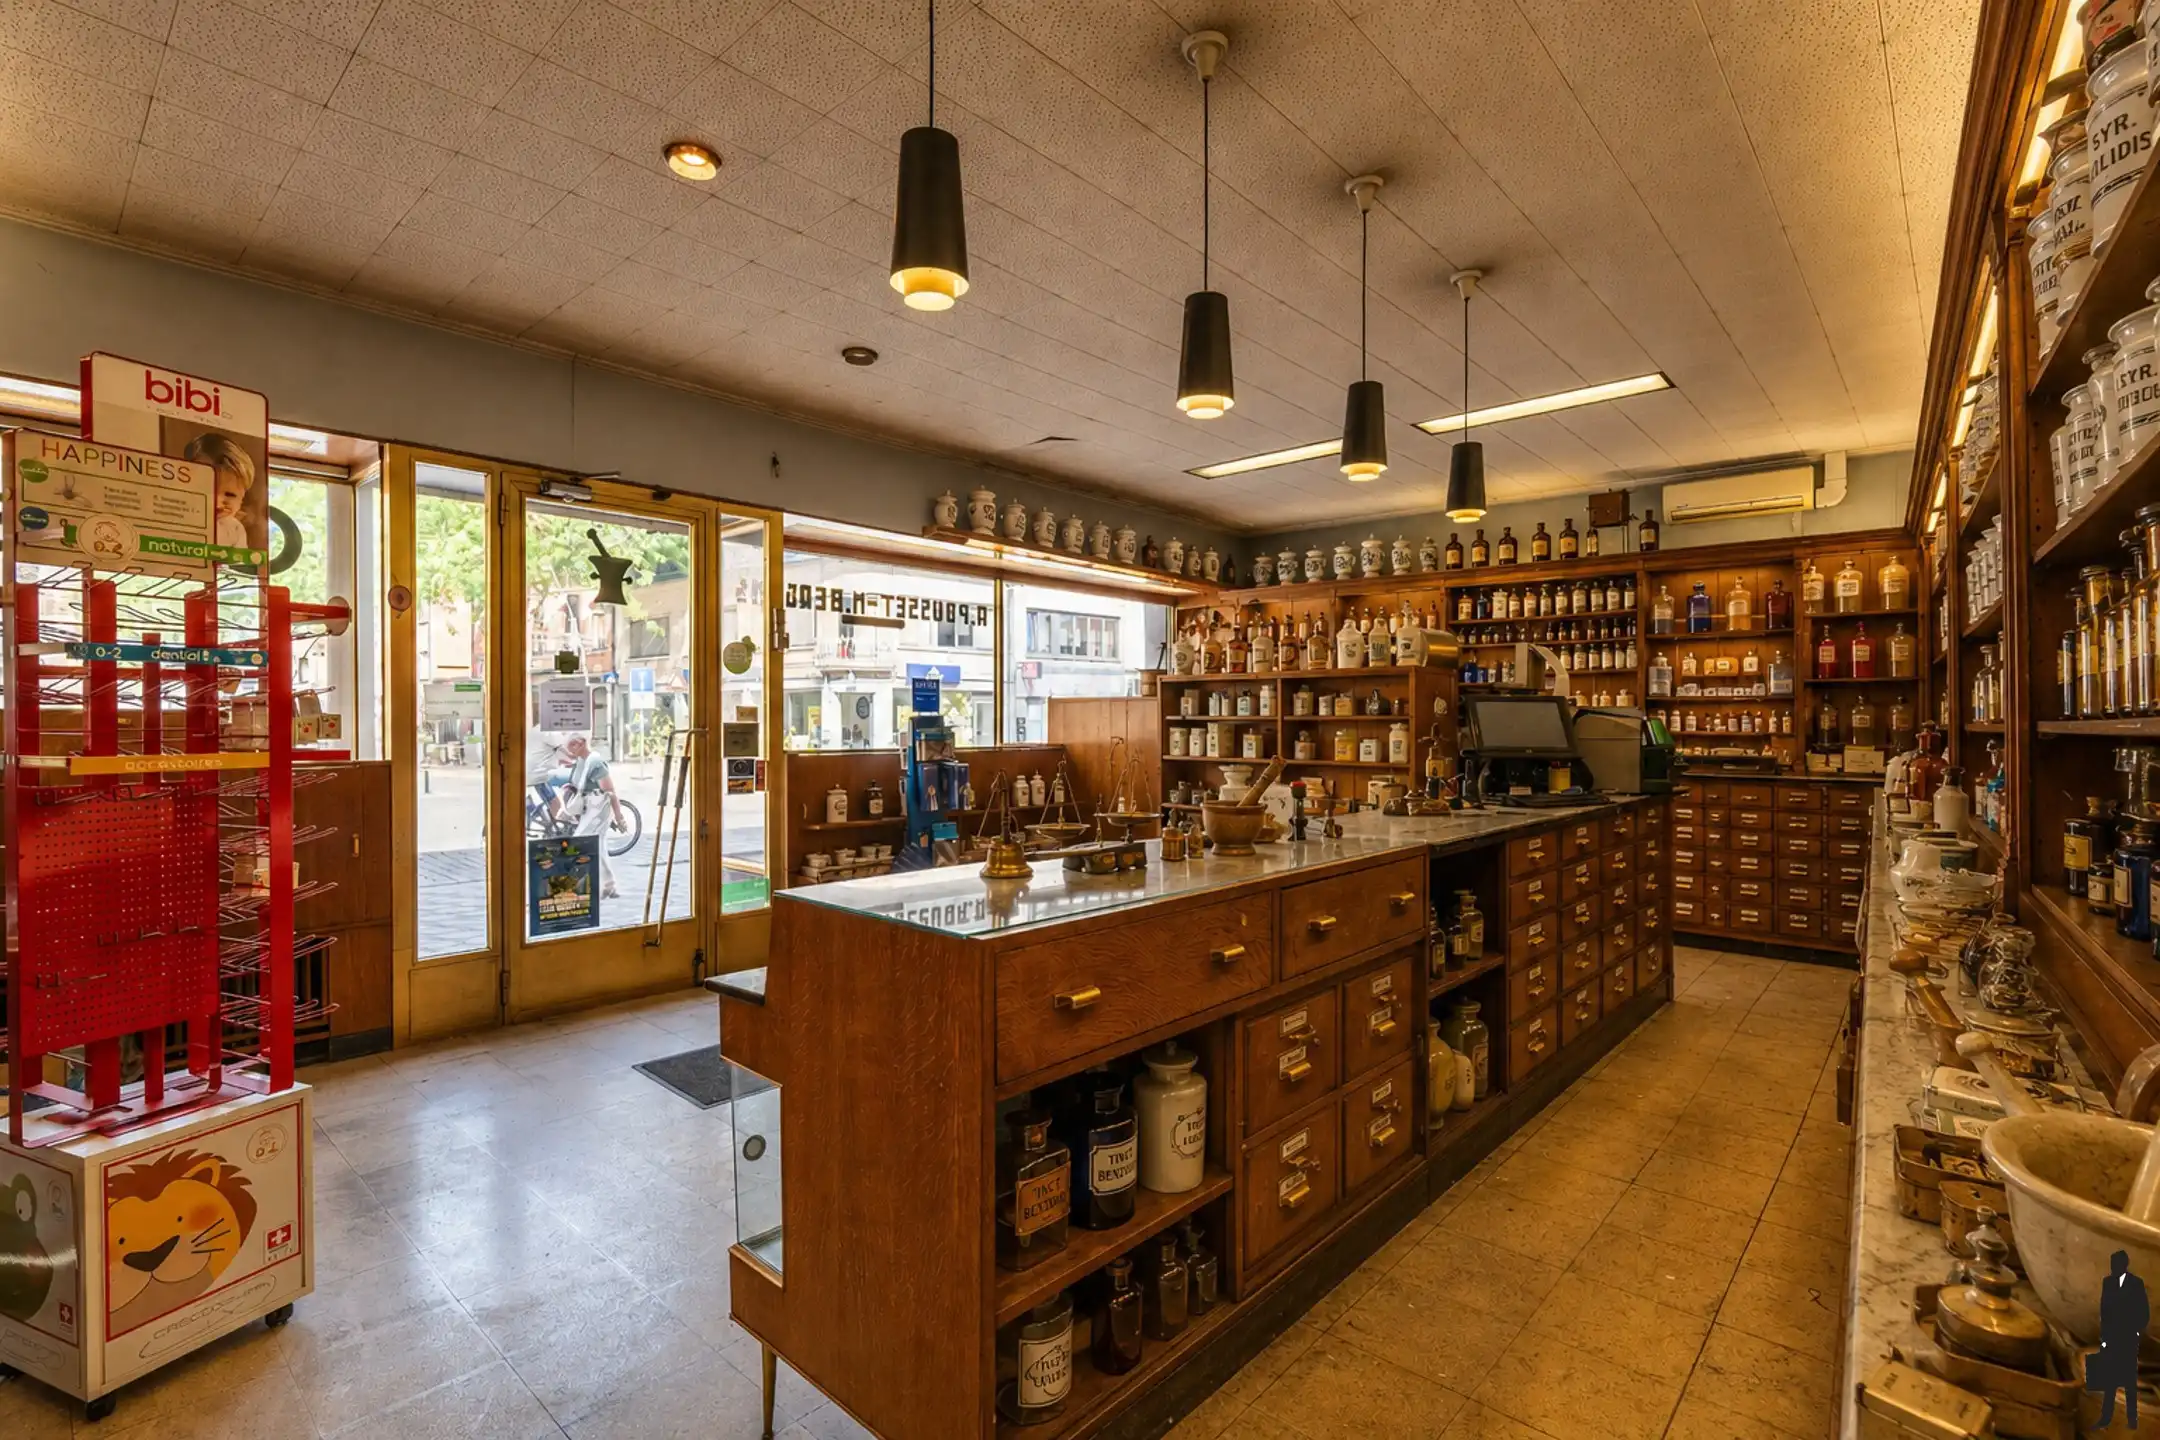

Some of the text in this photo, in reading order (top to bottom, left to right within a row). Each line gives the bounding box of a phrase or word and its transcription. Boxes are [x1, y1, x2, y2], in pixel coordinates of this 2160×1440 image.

[2092, 113, 2137, 151] SYR.
[145, 369, 220, 416] bibi
[42, 439, 192, 484] HAPPINESS
[149, 540, 209, 558] natural
